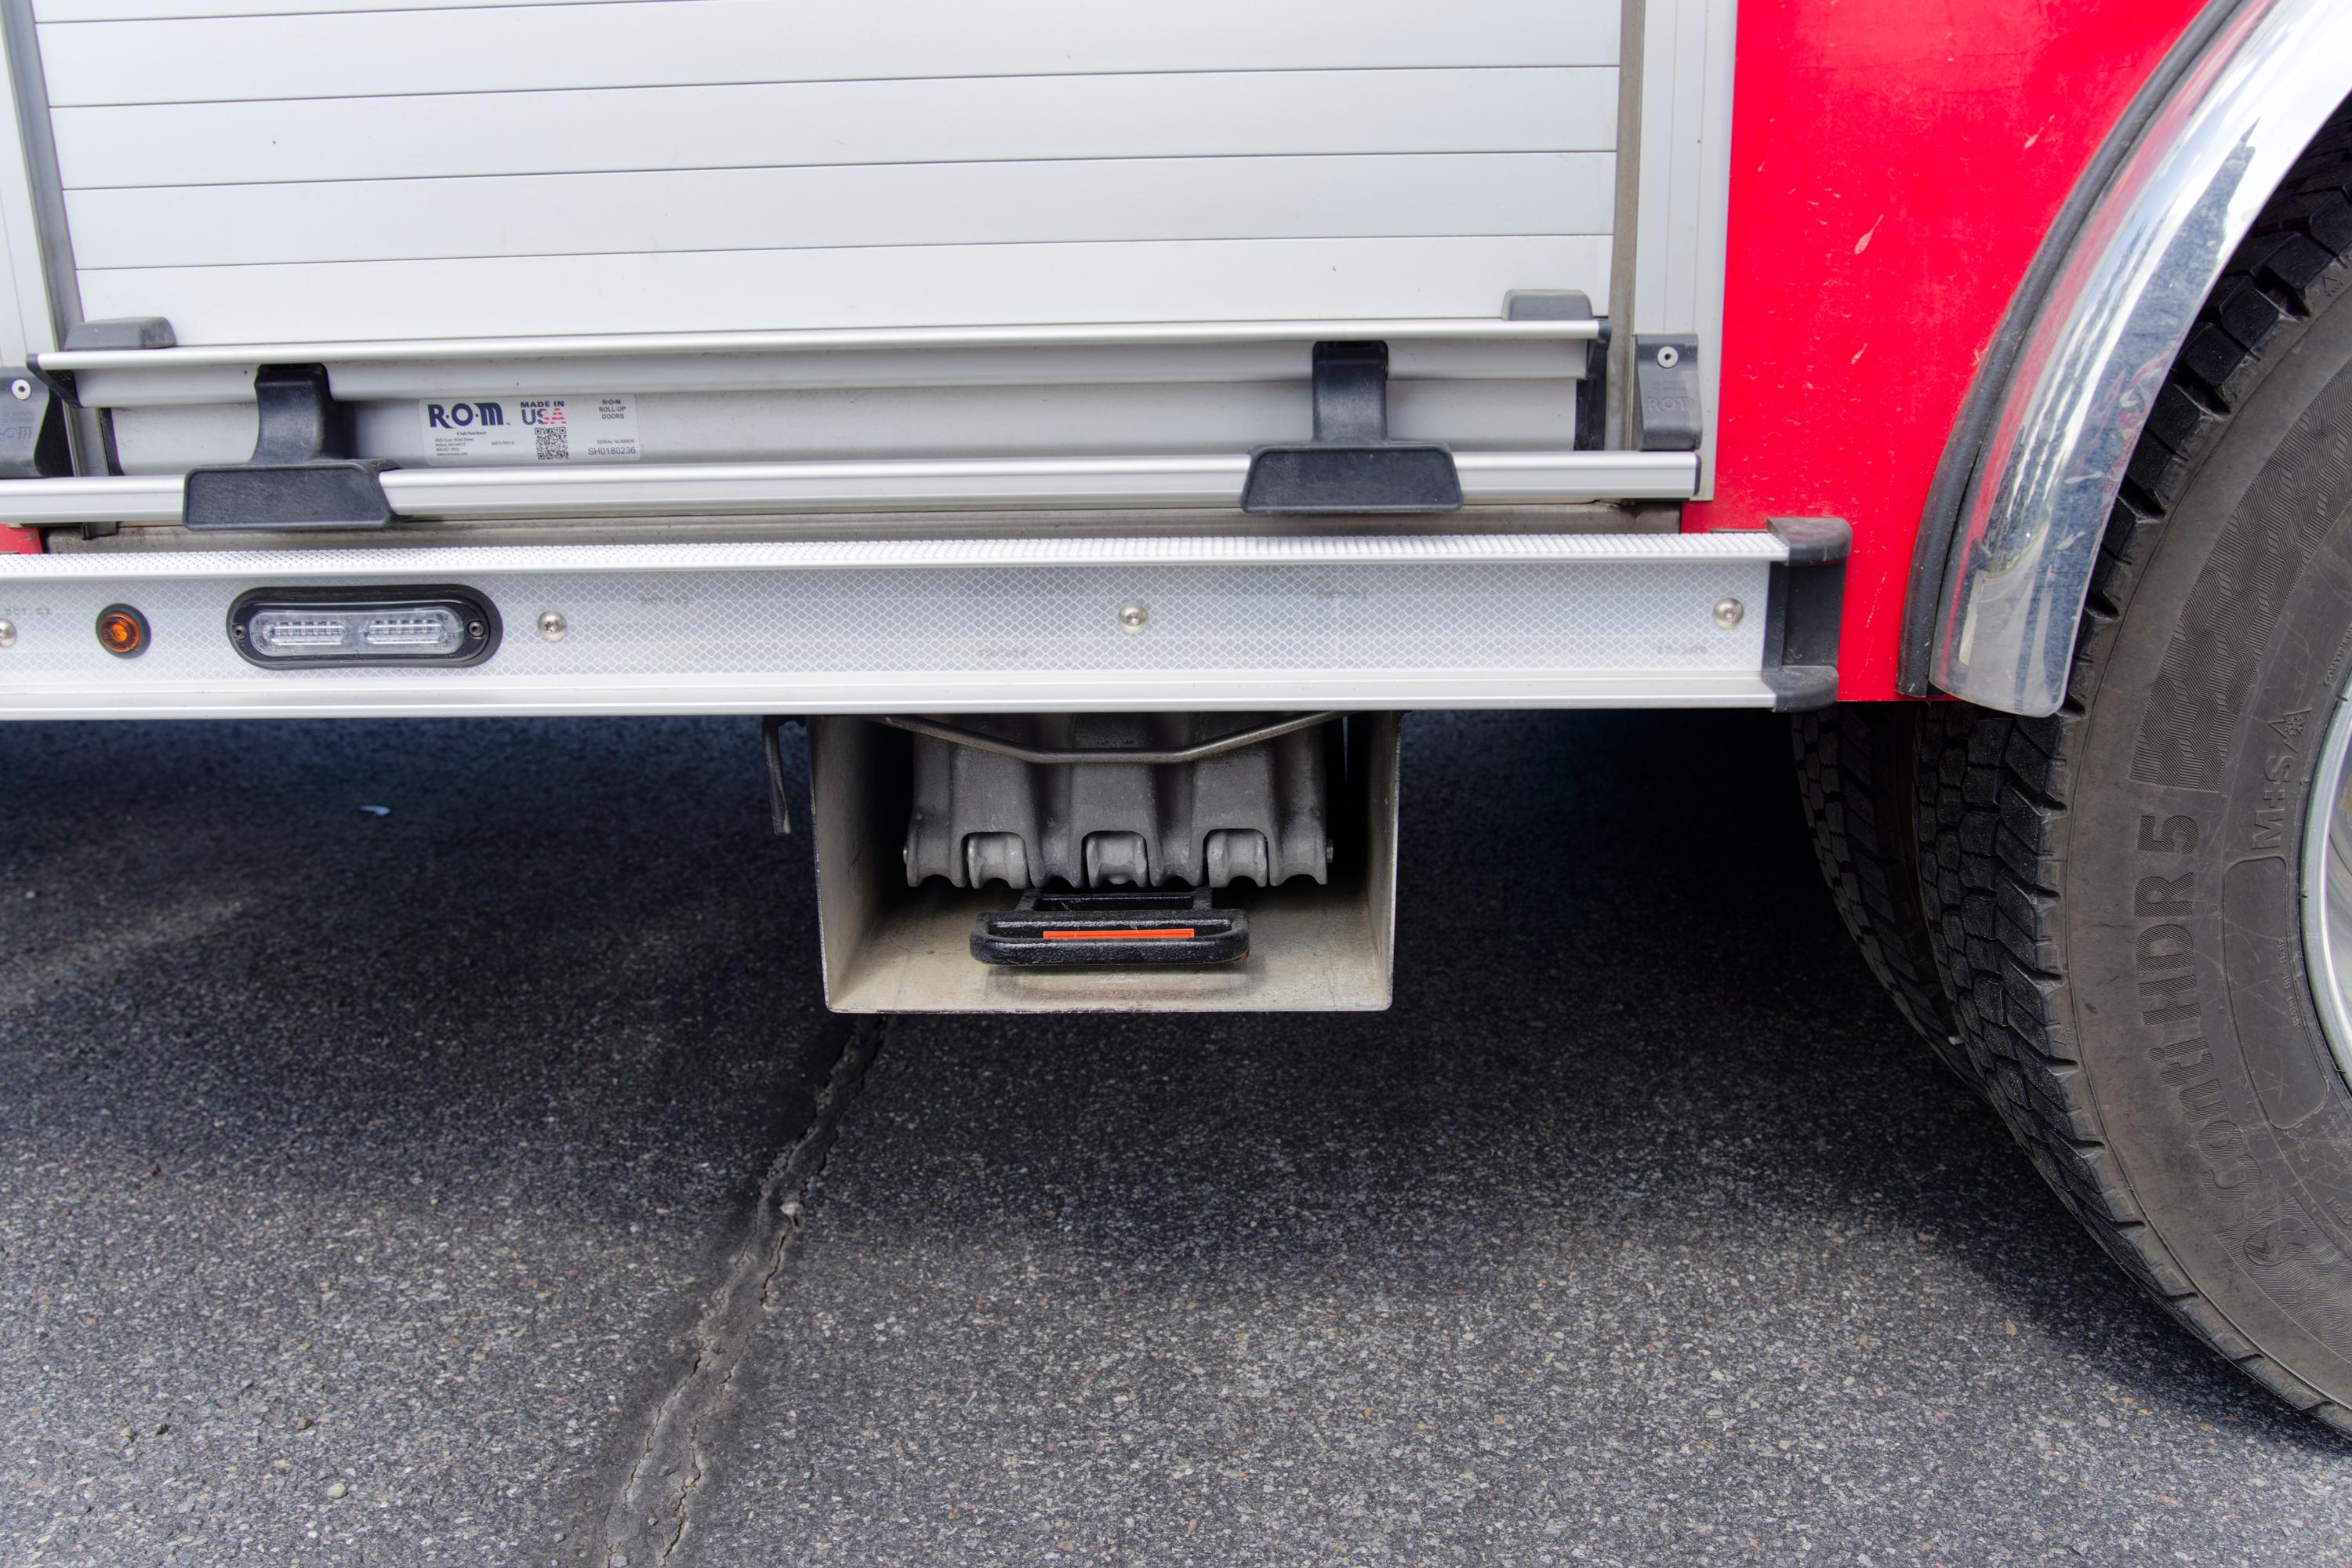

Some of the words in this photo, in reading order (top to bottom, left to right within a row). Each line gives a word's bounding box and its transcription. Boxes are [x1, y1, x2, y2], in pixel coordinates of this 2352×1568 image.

[521, 408, 567, 426] USA
[588, 447, 636, 456] SH0180236
[2137, 814, 2198, 855] 5
[2251, 755, 2296, 850] M+S
[2132, 871, 2202, 1025] HDR
[2148, 1036, 2261, 1201] Conti
